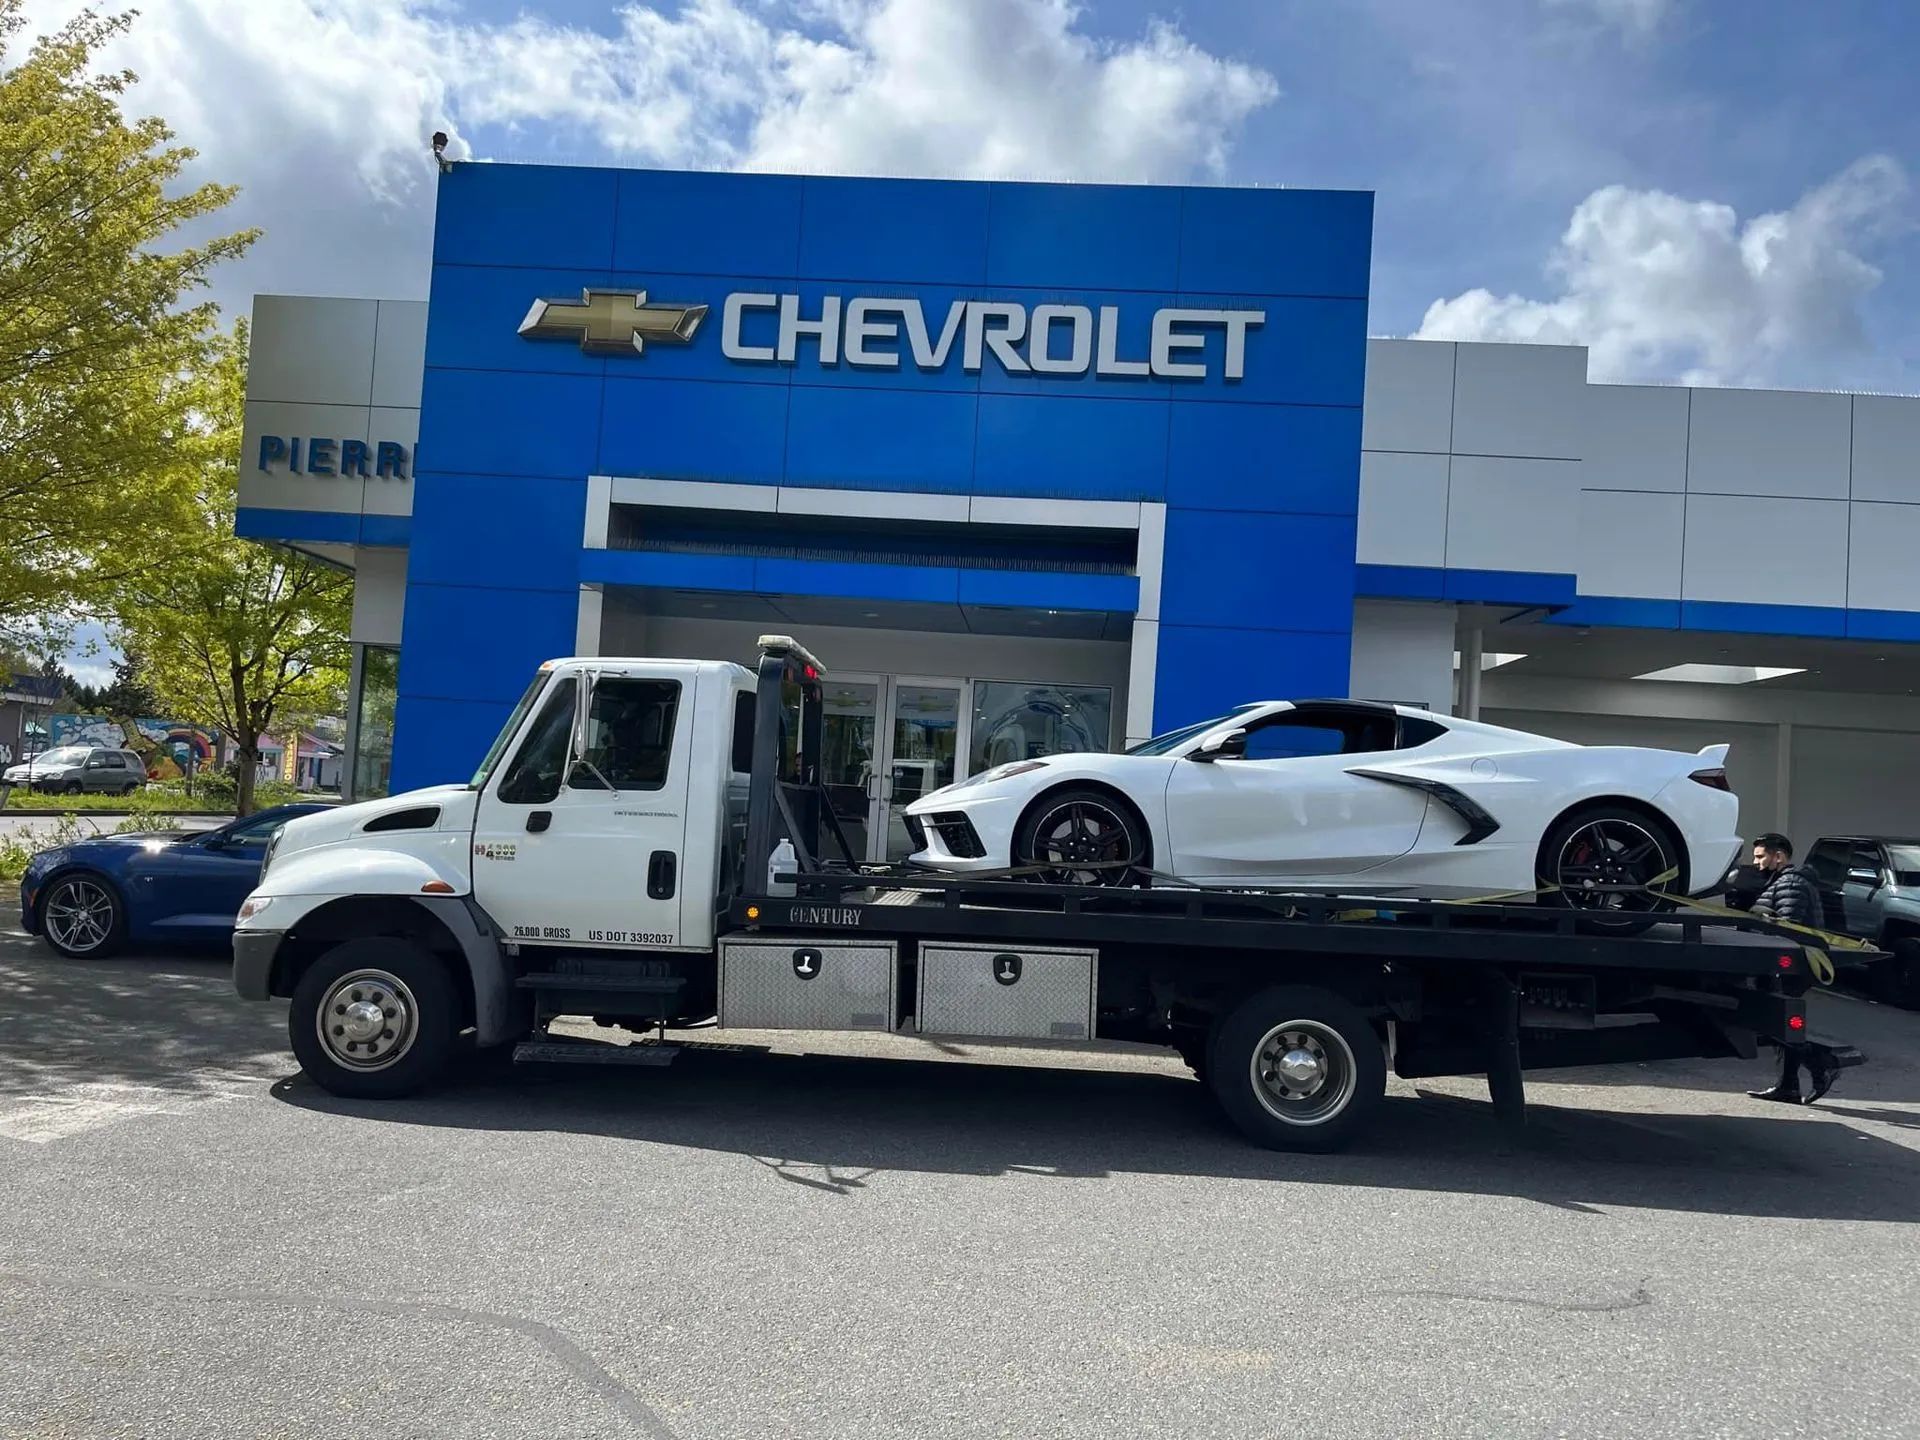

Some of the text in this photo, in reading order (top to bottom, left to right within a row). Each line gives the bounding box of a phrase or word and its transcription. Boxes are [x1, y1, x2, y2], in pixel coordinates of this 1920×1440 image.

[721, 292, 1265, 380] CHEVROLET
[258, 436, 418, 479] PIERR
[790, 907, 862, 925] CENTURY
[543, 927, 570, 938] GROSS
[588, 930, 673, 944] US DOT 3392037
